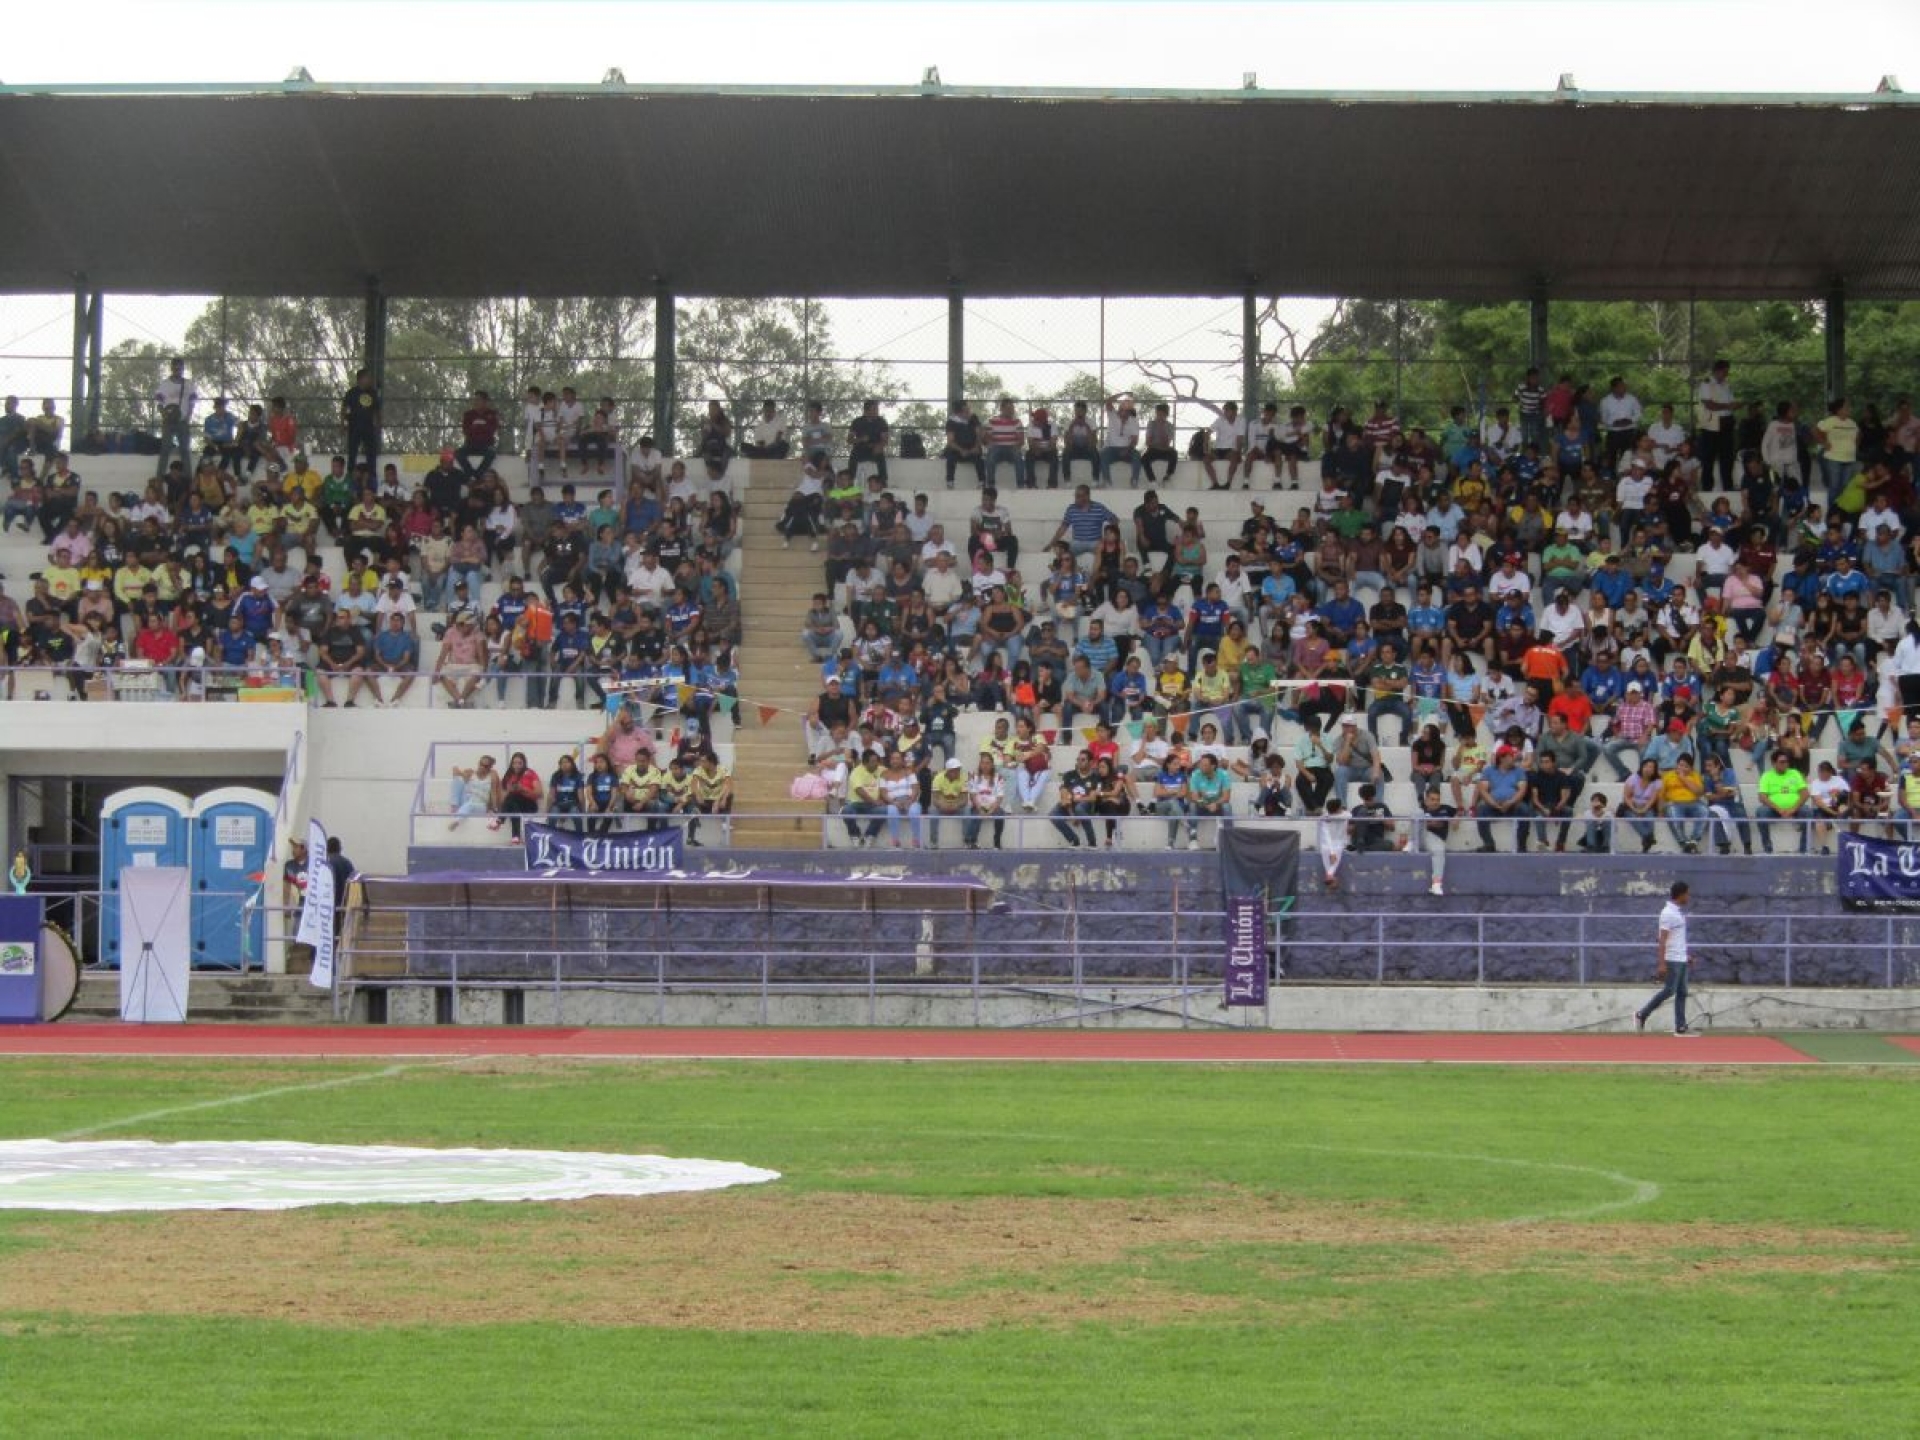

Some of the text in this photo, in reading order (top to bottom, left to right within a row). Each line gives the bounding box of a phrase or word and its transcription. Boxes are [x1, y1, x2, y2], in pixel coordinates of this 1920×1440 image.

[530, 832, 675, 870] La Unión
[1845, 842, 1888, 876] La
[1229, 904, 1254, 1000] La Unión
